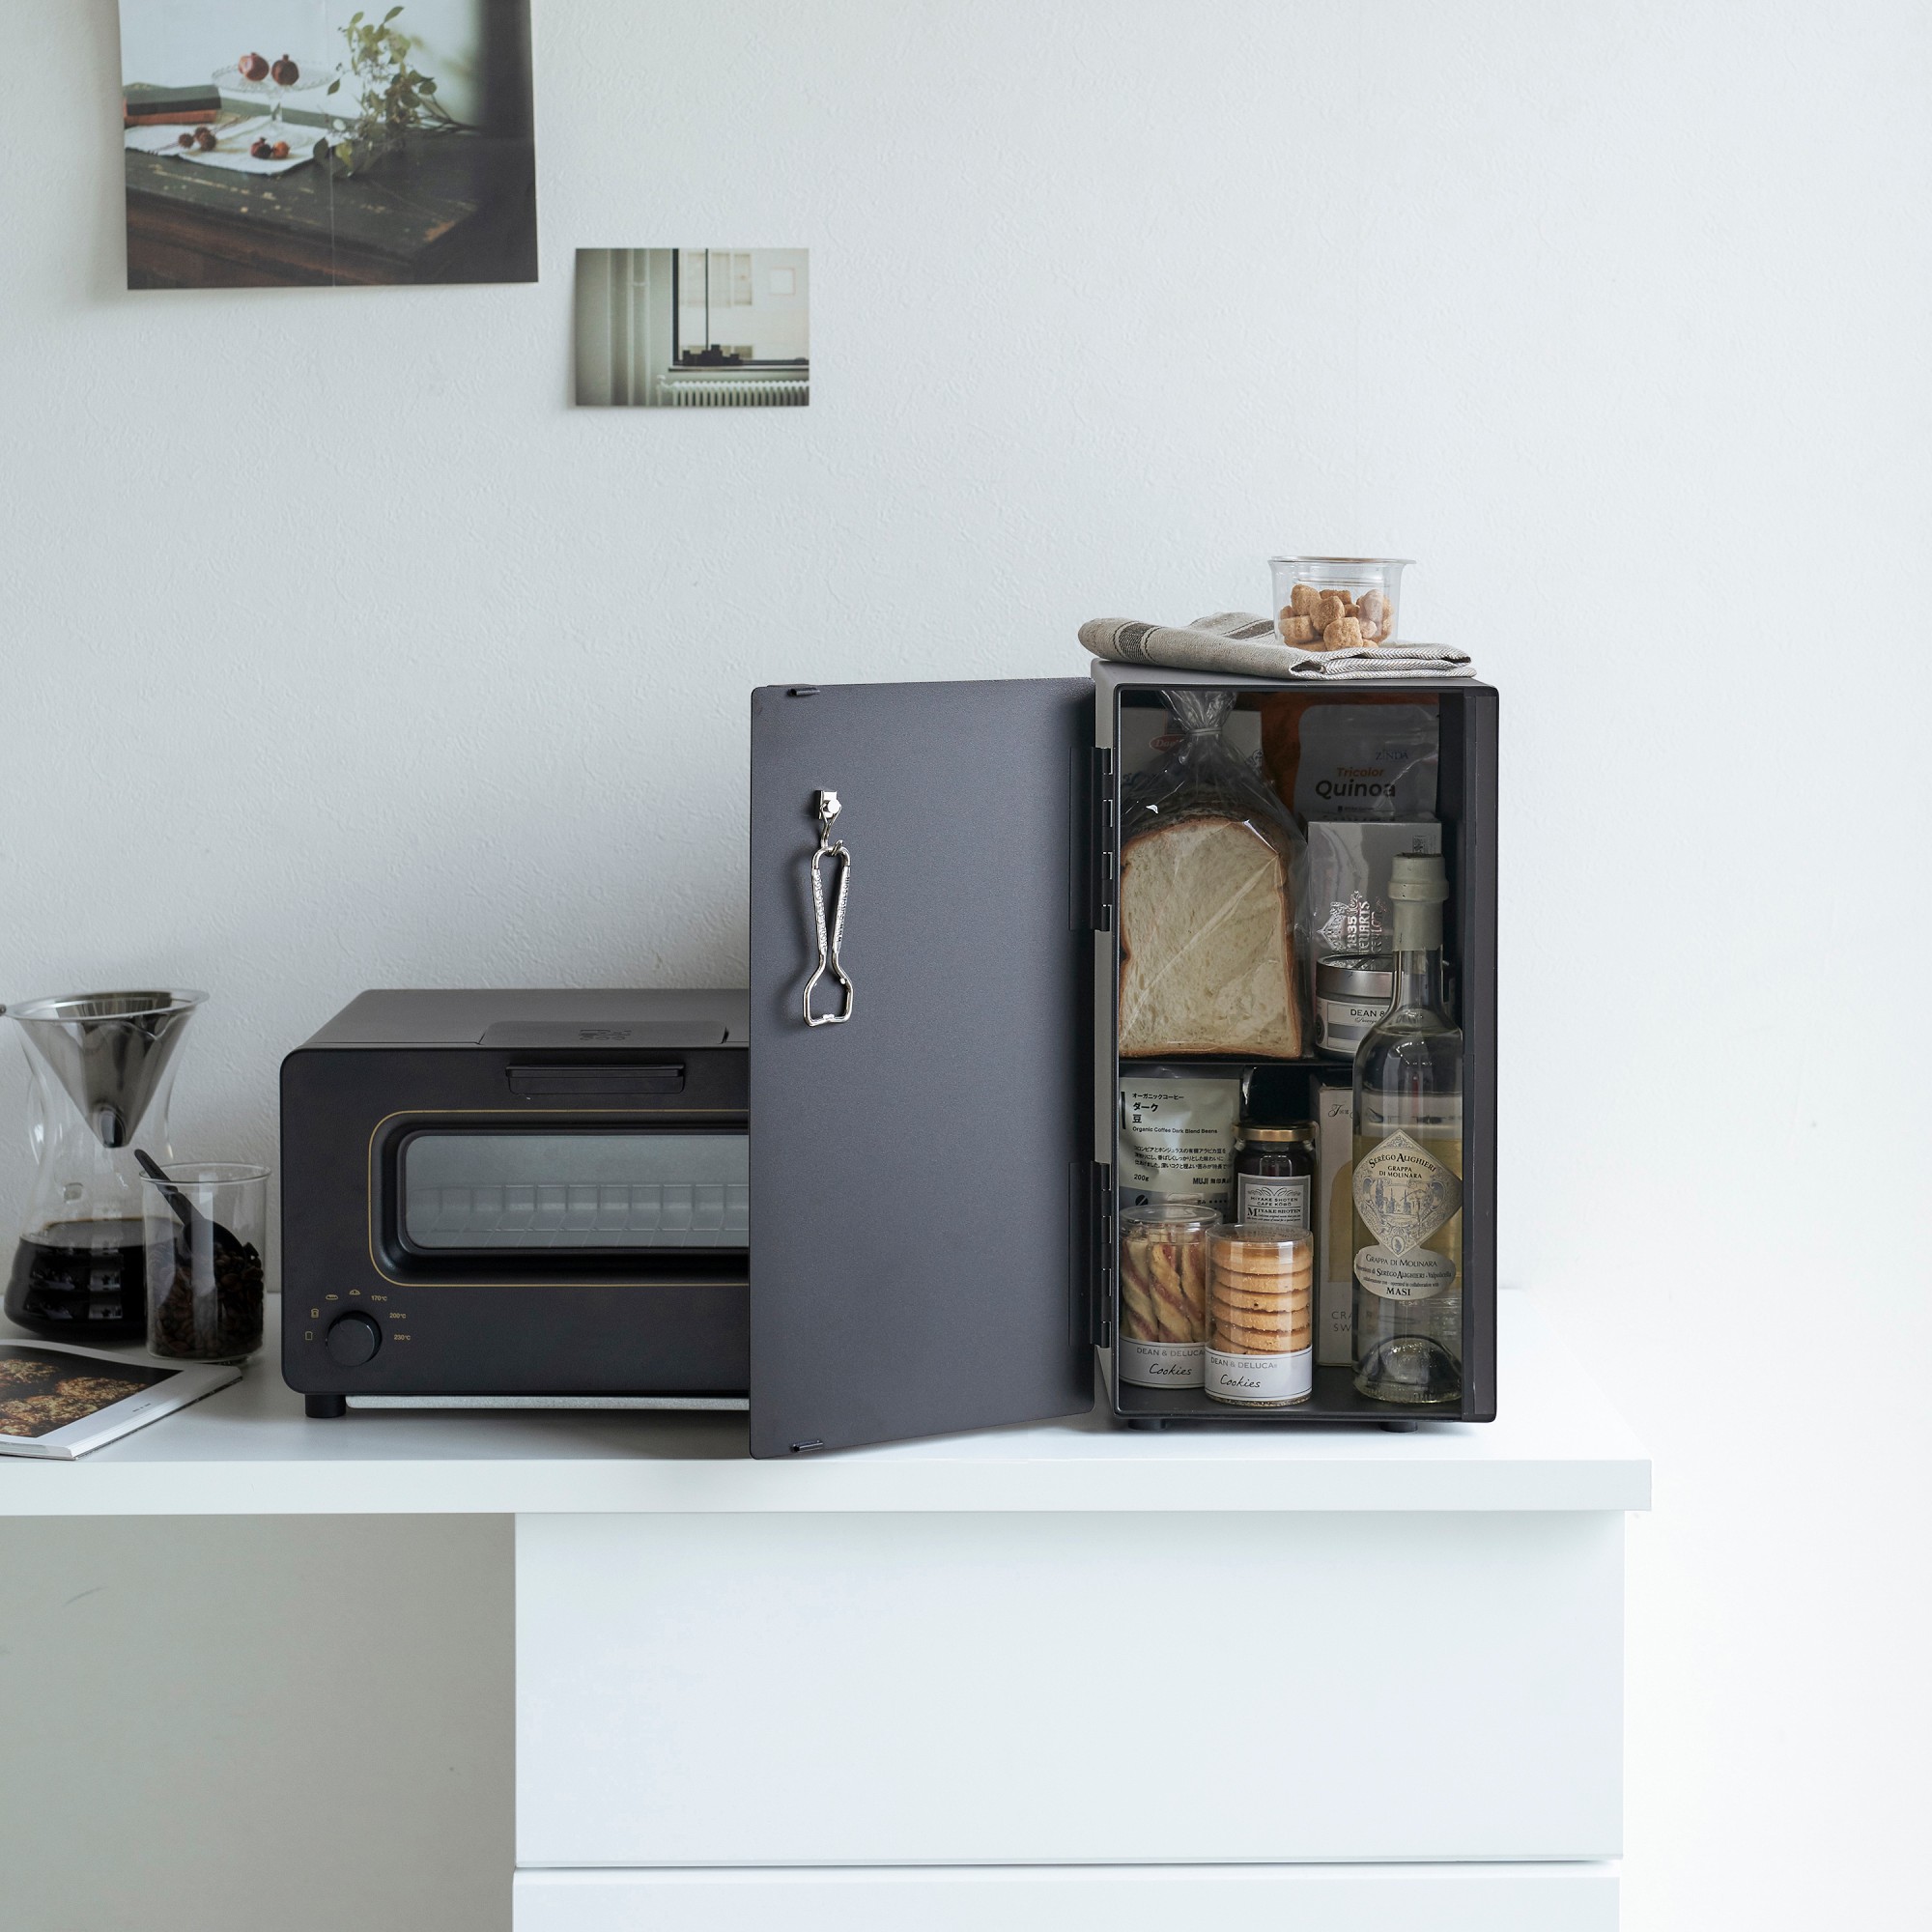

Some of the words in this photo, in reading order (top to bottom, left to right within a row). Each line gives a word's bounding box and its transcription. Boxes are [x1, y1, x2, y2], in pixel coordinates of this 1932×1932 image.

[1336, 767, 1384, 778] Tricolor
[1315, 780, 1396, 800] Quinoa
[1350, 1009, 1377, 1017] DEAN
[1133, 1102, 1158, 1112] ダーク
[1132, 1114, 1142, 1123] 豆
[1396, 1152, 1436, 1172] ALIGHIERI
[1247, 1208, 1276, 1216] MIYAKE
[1365, 1254, 1388, 1264] GRAPPA
[1399, 1259, 1437, 1267] MOLINARA
[1385, 1287, 1410, 1295] MASI
[1136, 1347, 1159, 1355] DEAN
[1210, 1356, 1229, 1366] DEAN
[1149, 1363, 1192, 1376] Cookies
[1220, 1374, 1261, 1388] Cookies
